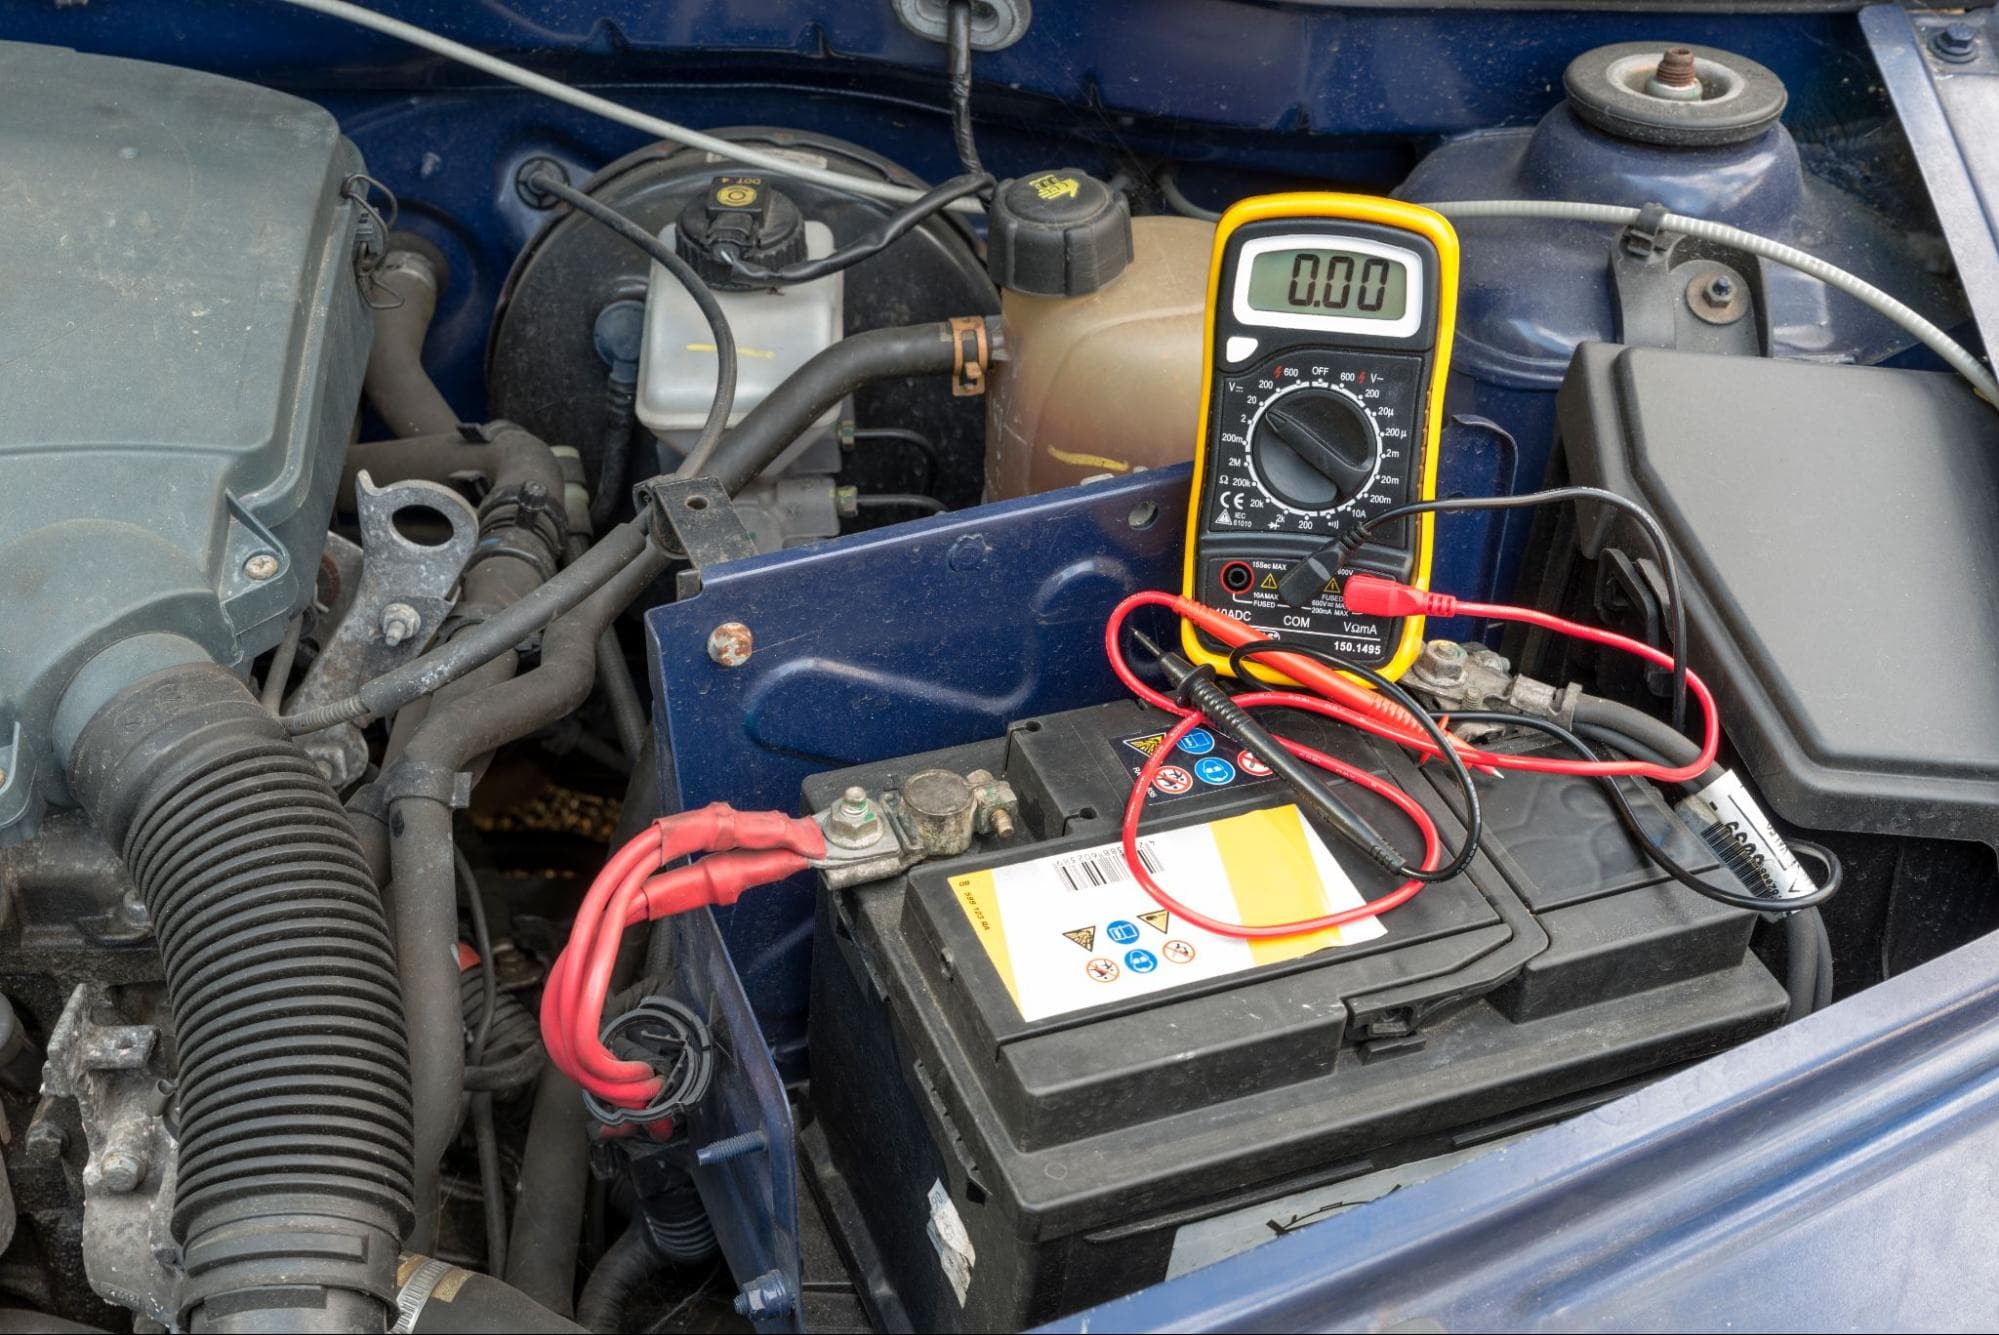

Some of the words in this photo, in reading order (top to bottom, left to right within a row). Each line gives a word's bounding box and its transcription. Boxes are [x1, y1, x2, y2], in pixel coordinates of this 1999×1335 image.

[1288, 253, 1389, 312] 0.00
[1283, 368, 1299, 378] 600
[1312, 366, 1329, 376] OFF
[1340, 372, 1355, 381] 600
[1258, 380, 1274, 390] 200
[1364, 389, 1380, 399] 200
[1247, 395, 1257, 405] 20
[1240, 414, 1247, 423] 2
[1221, 432, 1244, 444] 200m
[1386, 448, 1400, 459] 2m
[1228, 457, 1241, 468] 2M
[1380, 475, 1399, 485] 20m
[1250, 498, 1264, 509] 20k
[1370, 494, 1391, 505] 200m
[1352, 509, 1366, 519] 10A
[1298, 520, 1314, 530] 200
[1272, 562, 1287, 571] MAX
[1253, 600, 1276, 609] FUSED
[1334, 609, 1349, 617] MAX
[1283, 615, 1311, 628] COM
[1333, 641, 1381, 655] 150.1495
